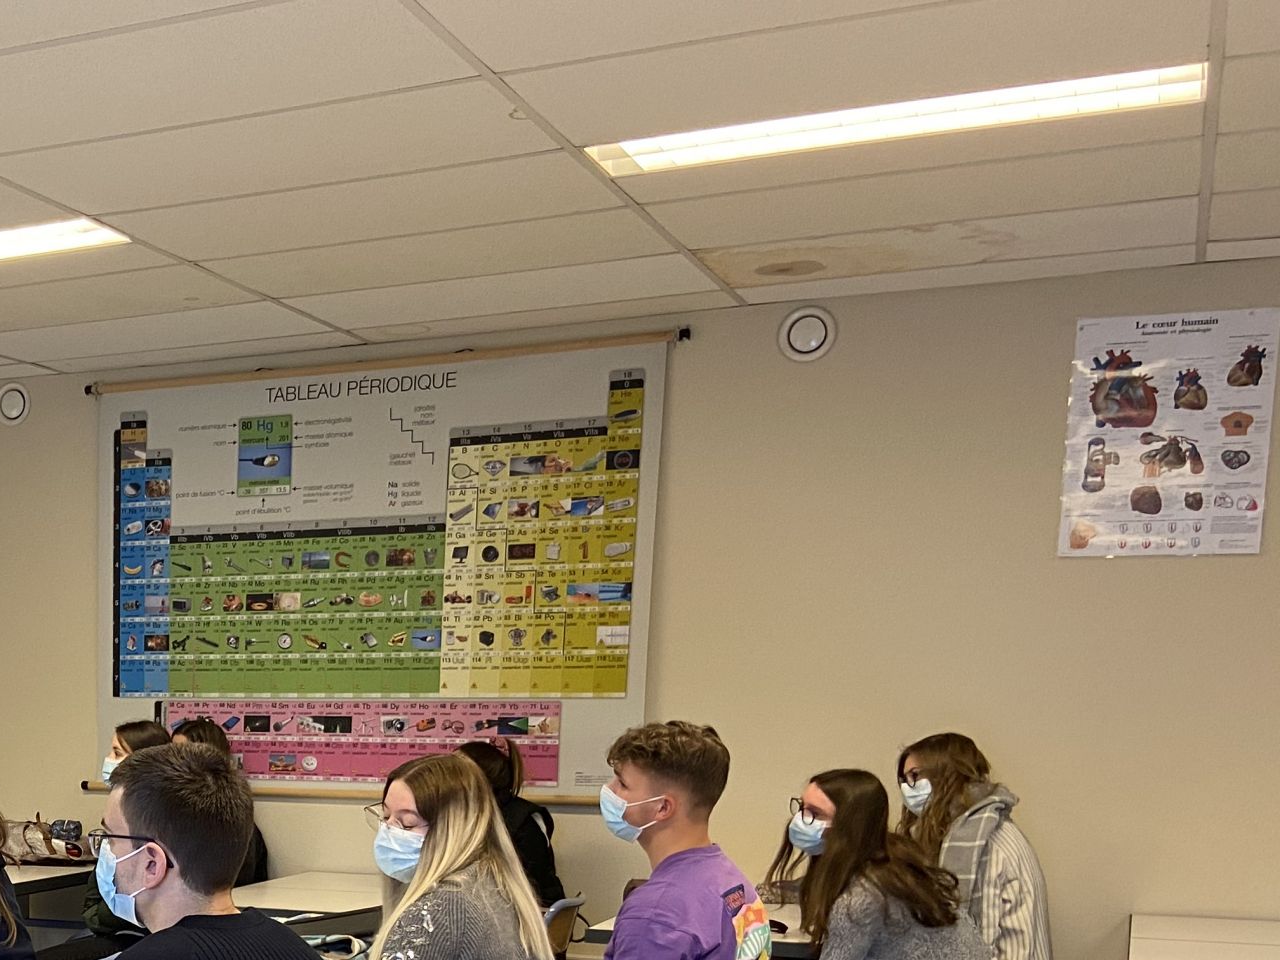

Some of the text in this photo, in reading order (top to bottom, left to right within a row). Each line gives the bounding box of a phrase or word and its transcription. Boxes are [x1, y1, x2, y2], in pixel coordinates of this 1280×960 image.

[1136, 321, 1149, 329] Le
[1182, 316, 1218, 327] humain
[266, 372, 457, 402] TABLEAU PÉRIODIQUE
[242, 420, 273, 433] 80 Hg
[388, 491, 397, 499] Hg
